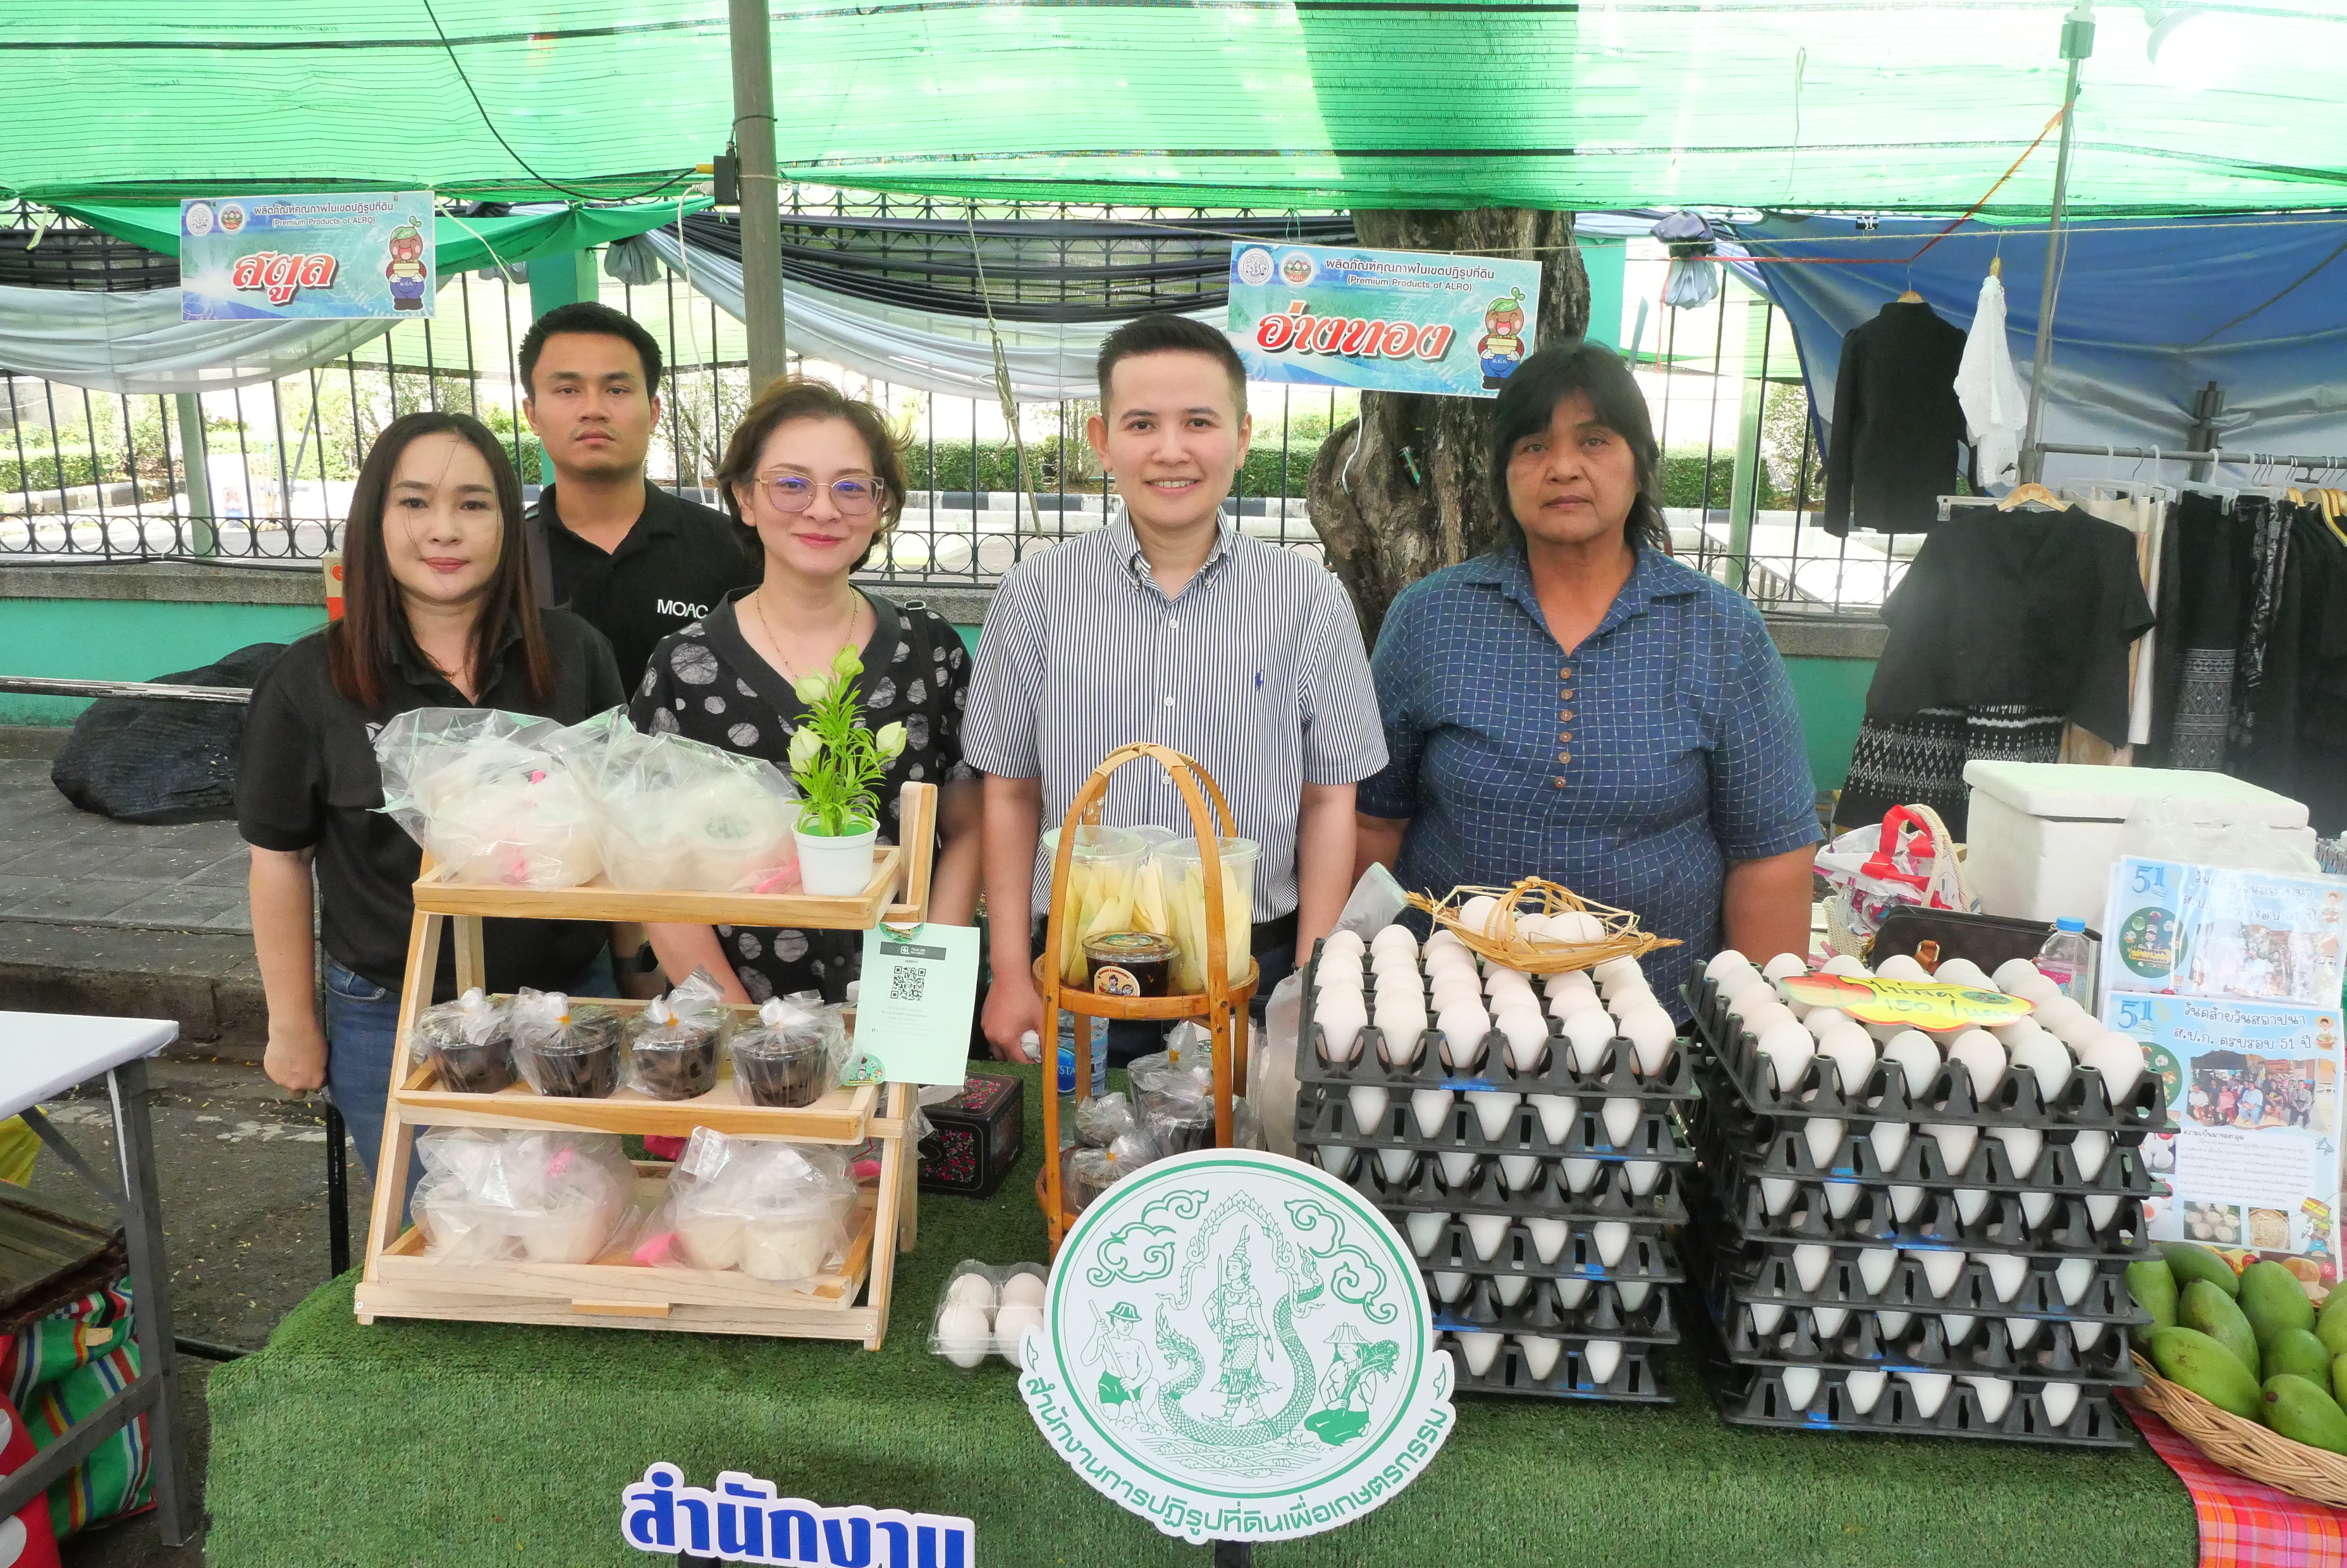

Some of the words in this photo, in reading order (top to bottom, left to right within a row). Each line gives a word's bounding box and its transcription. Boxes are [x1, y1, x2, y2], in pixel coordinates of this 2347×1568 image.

[254, 200, 394, 217] ผลิตภัณฑ์คุณภาพในเขตปฏิรูปที่ดิน
[272, 218, 306, 228] (Premium
[308, 217, 340, 226] Products
[233, 251, 336, 305] สตูล
[1325, 257, 1495, 280] ผลิตภัณฑ์คุณภาพในเขตปฏิรูปที่ดิน
[1347, 275, 1389, 286] (Premium
[1392, 278, 1430, 289] Products
[1445, 282, 1473, 293] ALRO)
[1256, 299, 1453, 360] อ่างทอง
[657, 599, 709, 620] MOAC
[2131, 865, 2165, 894] 51
[2117, 1000, 2154, 1029] 51
[2183, 1001, 2307, 1026] วันคล้ายวันสถาปนา
[2173, 1027, 2214, 1045] ส.ป.ก.
[2219, 1036, 2275, 1050] ครบรอบ
[2280, 1038, 2295, 1050] 51
[2300, 1034, 2312, 1050] ปี
[1026, 1377, 1449, 1537] สำนักงานการปฏิรูปที่ดินเพื่อเกษตรกรรม
[629, 1471, 965, 1568] สำนักงาน
